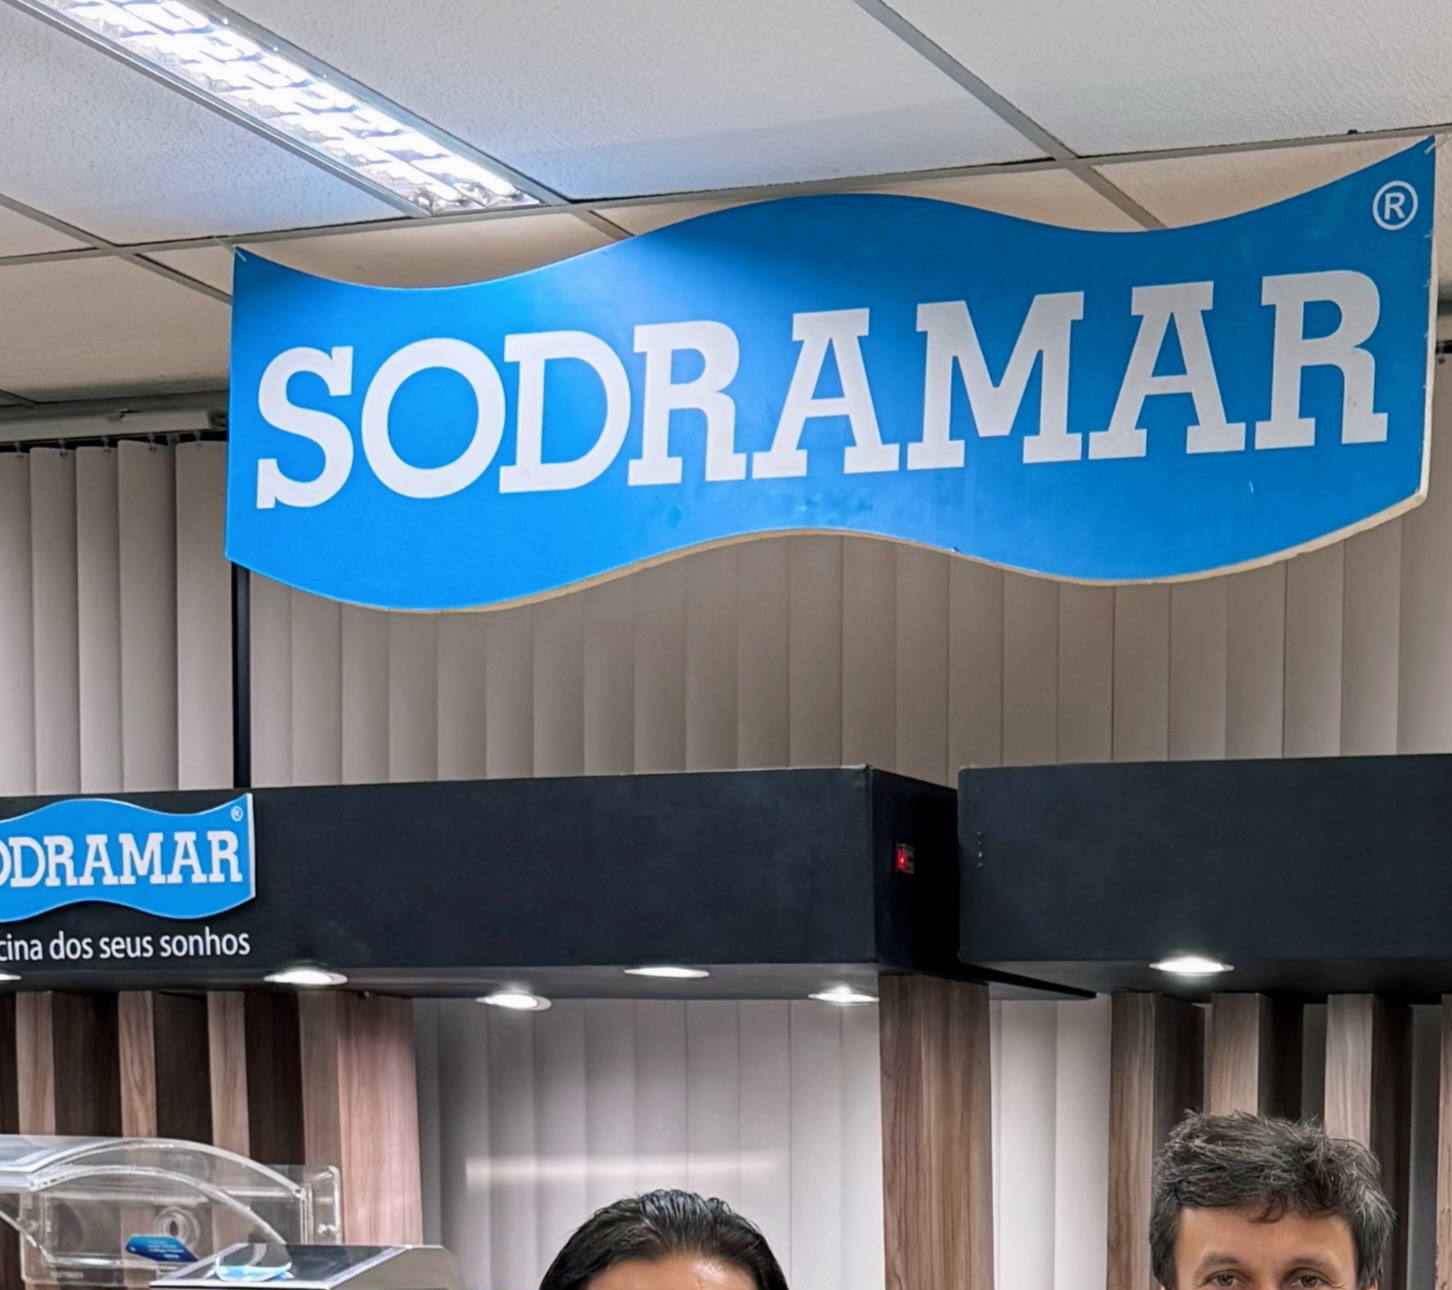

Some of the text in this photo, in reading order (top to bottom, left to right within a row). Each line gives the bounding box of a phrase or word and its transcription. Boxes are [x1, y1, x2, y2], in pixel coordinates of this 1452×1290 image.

[256, 269, 1389, 510] SODRAMAR
[50, 930, 94, 961] dos
[99, 935, 154, 959] seus
[159, 926, 251, 958] sonhos
